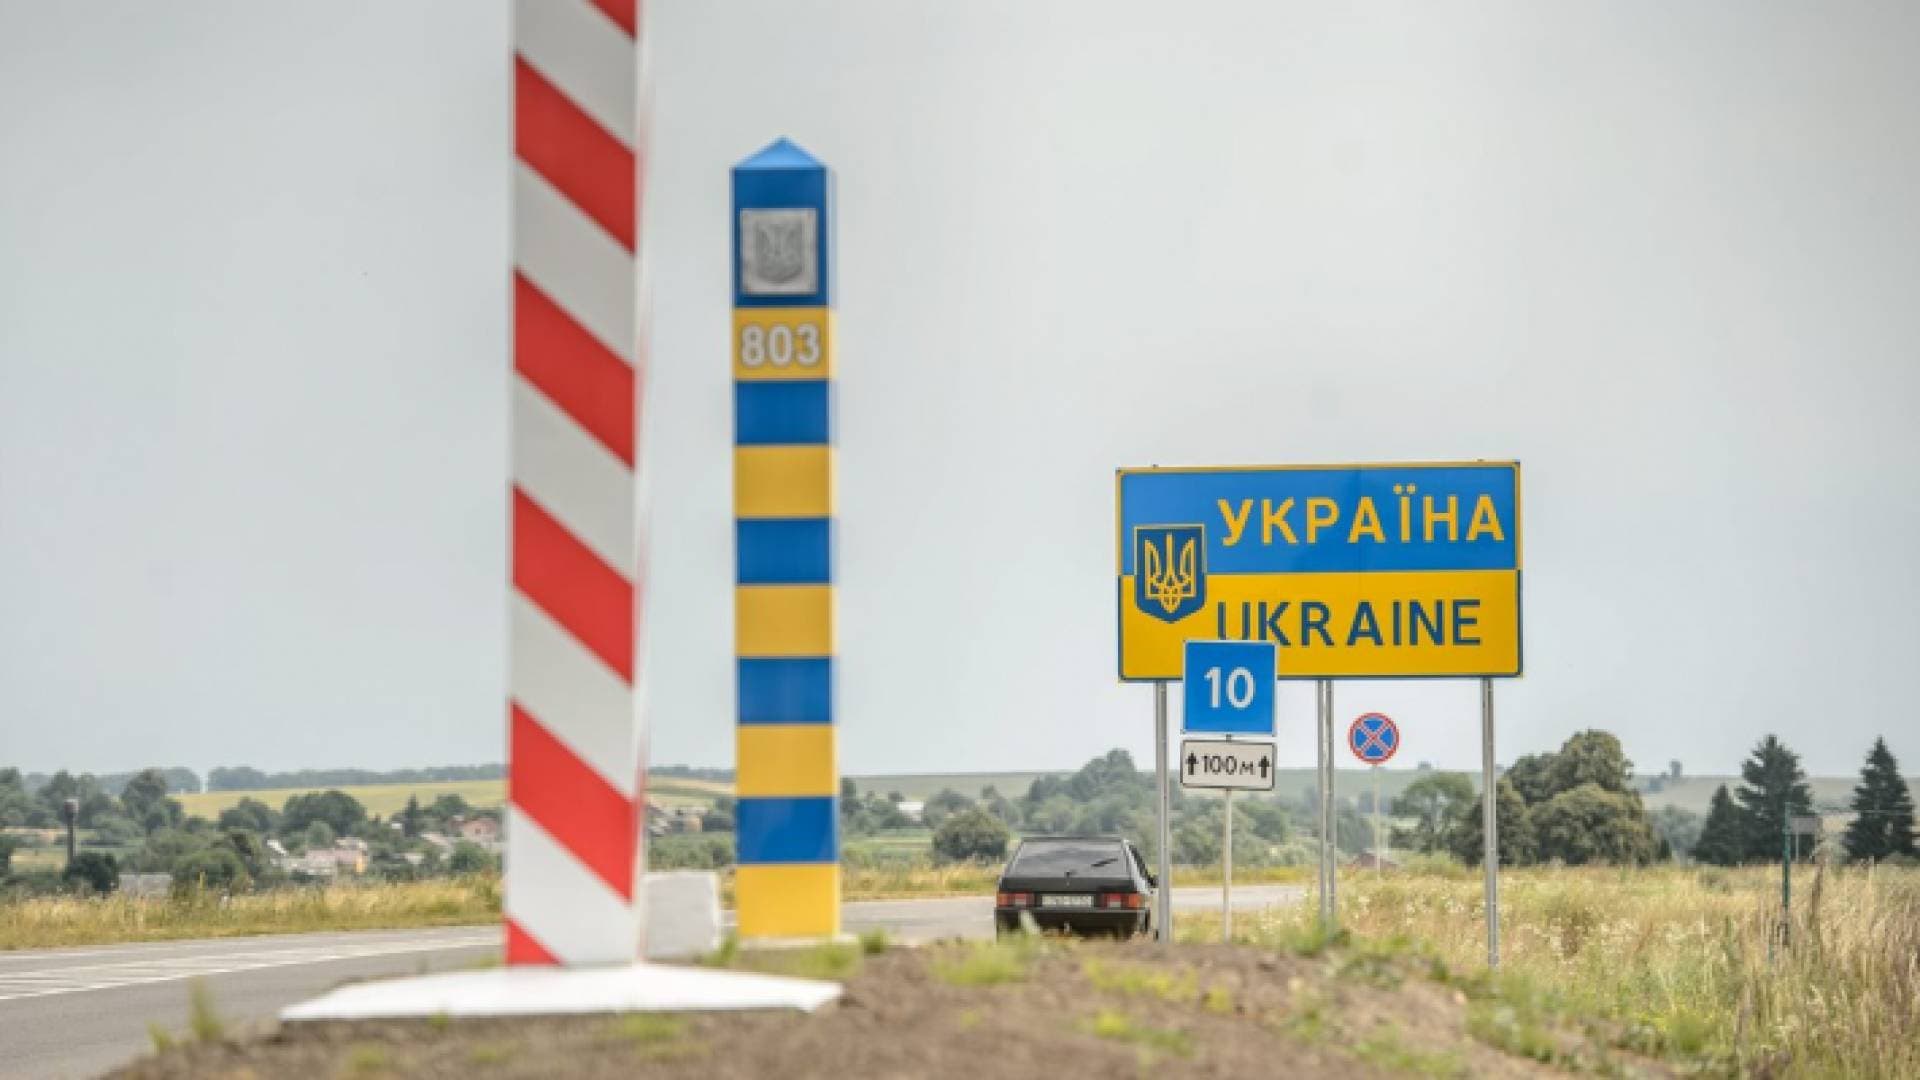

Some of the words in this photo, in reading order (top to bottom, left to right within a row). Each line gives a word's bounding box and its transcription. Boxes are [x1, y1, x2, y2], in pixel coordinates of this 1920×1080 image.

[740, 323, 821, 368] 803
[1217, 483, 1505, 547] УКРАЇНА
[1217, 599, 1481, 647] UKRAINE
[1204, 666, 1255, 709] 10
